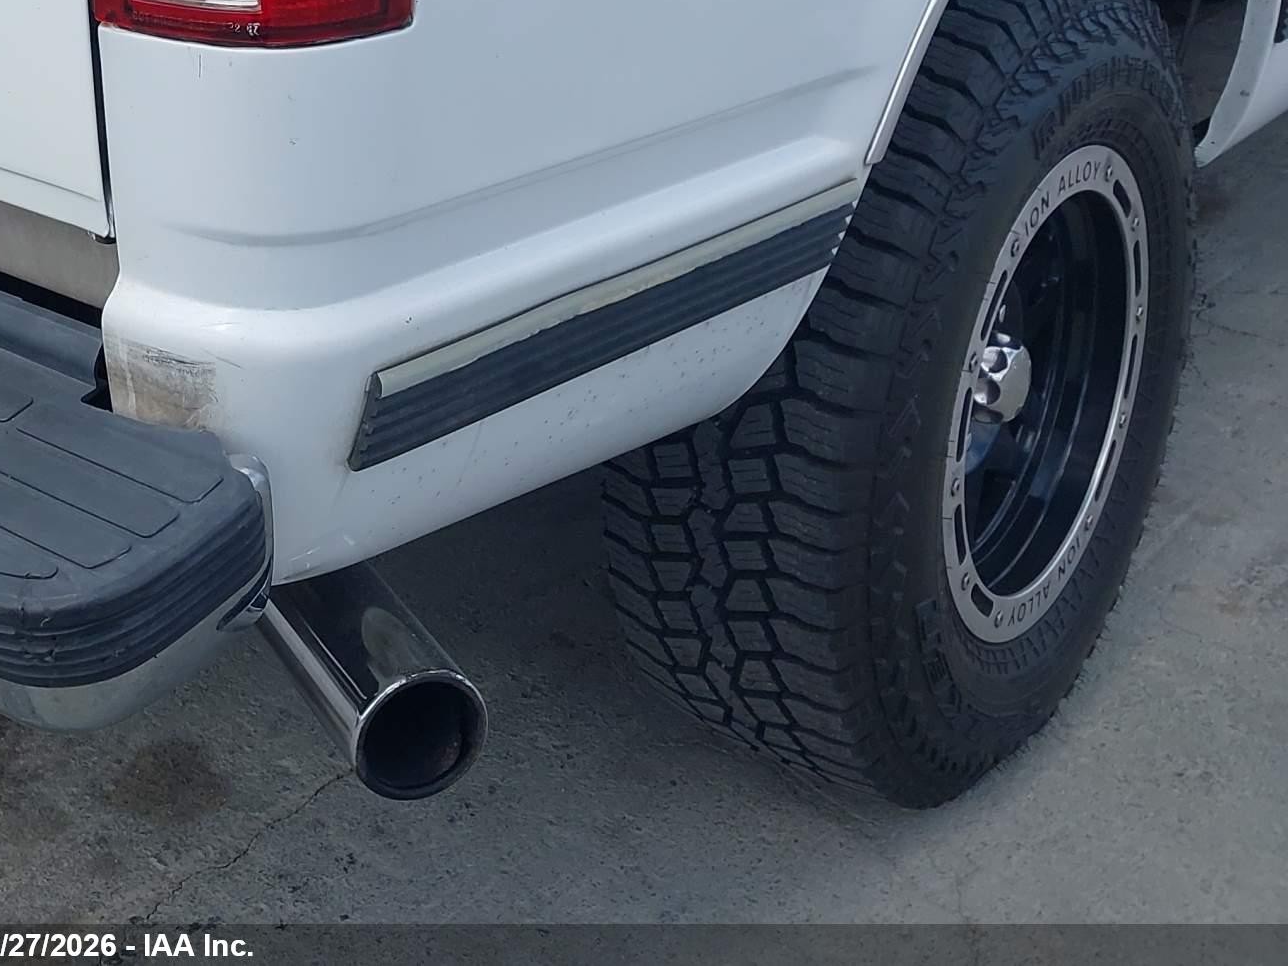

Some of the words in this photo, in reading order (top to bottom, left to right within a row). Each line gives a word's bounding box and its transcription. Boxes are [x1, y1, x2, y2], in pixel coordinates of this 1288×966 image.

[1024, 191, 1050, 237] ION
[1058, 160, 1102, 197] ALLOY
[1058, 536, 1081, 581] ION
[1007, 579, 1051, 627] ALLOY
